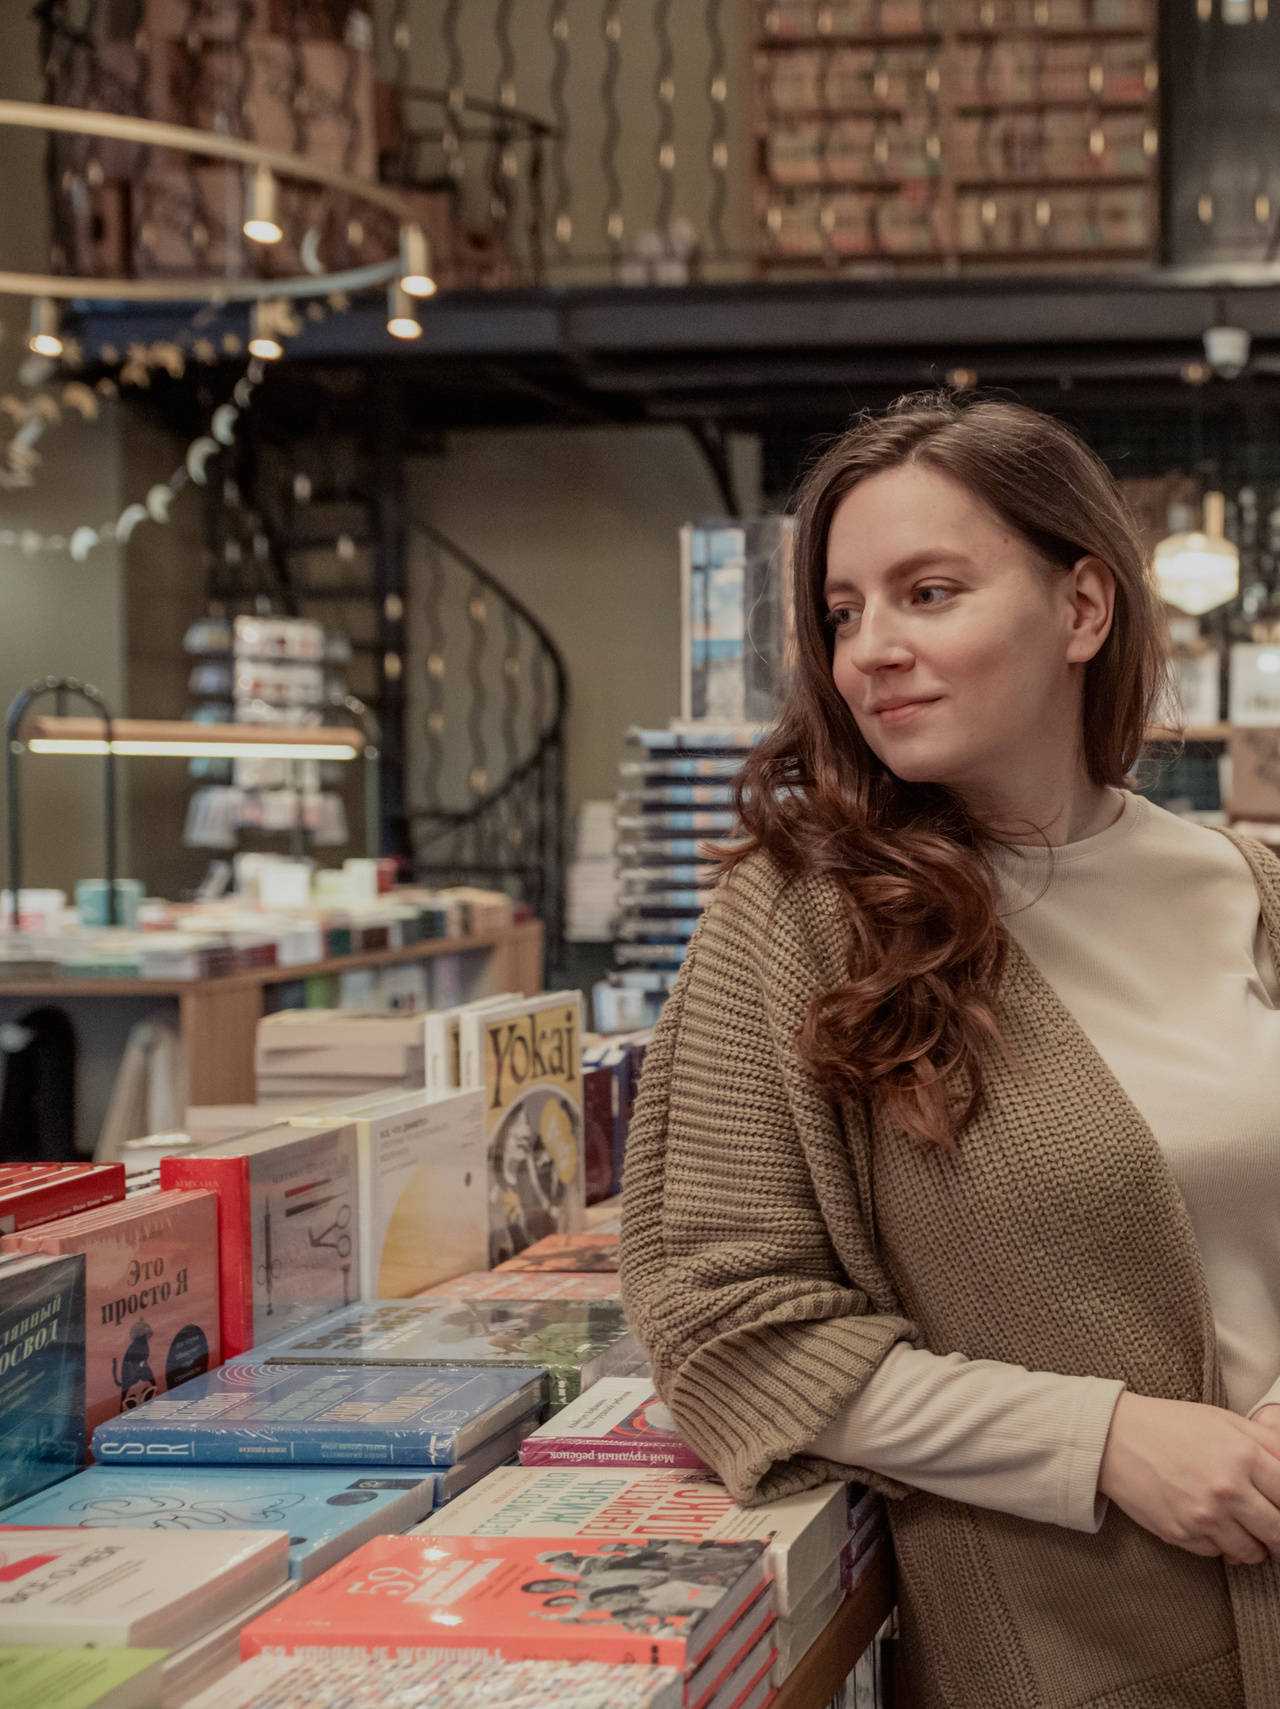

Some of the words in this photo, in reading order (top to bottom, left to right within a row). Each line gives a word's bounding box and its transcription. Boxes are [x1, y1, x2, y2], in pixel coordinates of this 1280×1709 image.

[488, 1009, 576, 1109] Yokai
[127, 1257, 165, 1287] Это
[101, 1281, 172, 1326] просто
[175, 1267, 189, 1297] Я
[550, 1450, 596, 1463] ребёнок
[596, 1451, 648, 1463] трудный
[649, 1453, 675, 1465] Мой
[470, 1472, 582, 1535] БЕССМЕРТНАЯ
[530, 1479, 628, 1524] ЖИЗНЬ
[575, 1474, 682, 1536] ГЕНРИЕТТЫ
[346, 1566, 437, 1596] 52
